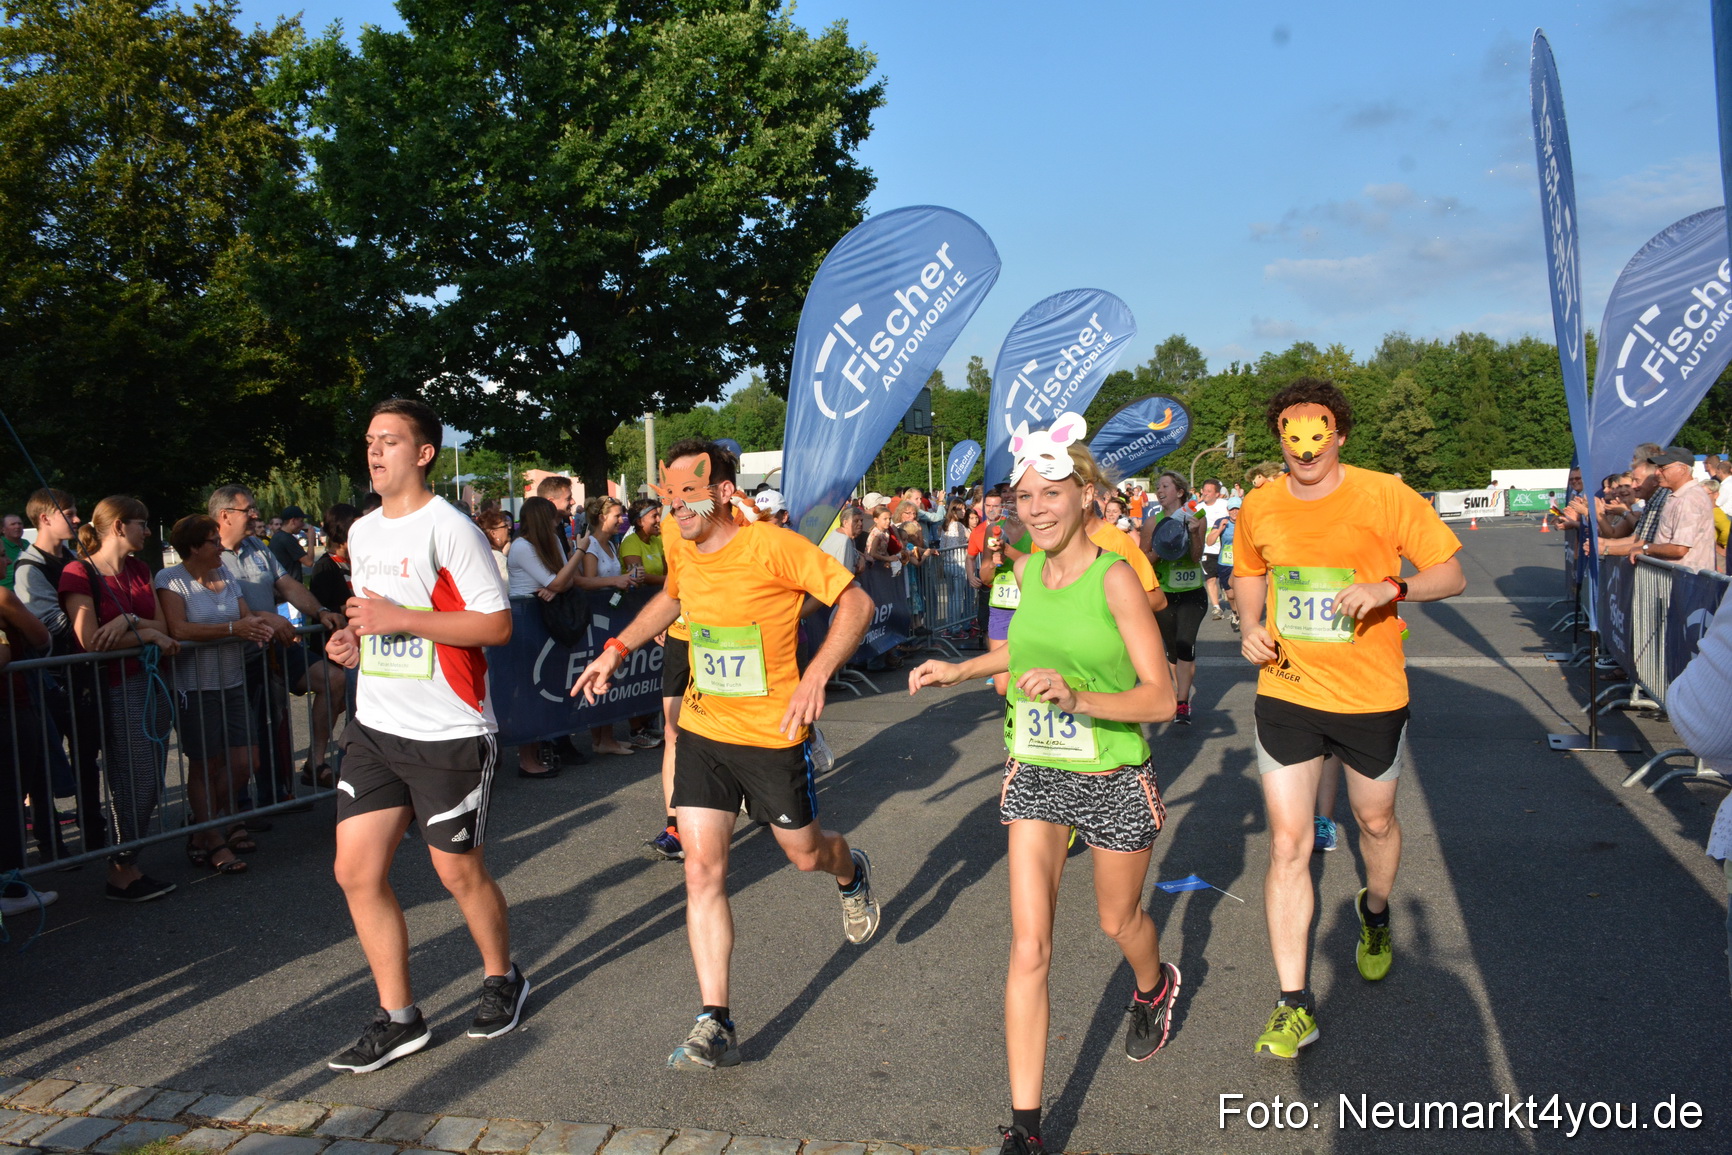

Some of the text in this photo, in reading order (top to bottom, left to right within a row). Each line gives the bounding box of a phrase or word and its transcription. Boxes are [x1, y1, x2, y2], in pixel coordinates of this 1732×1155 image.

[841, 241, 954, 394] Fischer
[881, 270, 968, 392] AUTOMOBILE
[1641, 257, 1731, 384] Fische
[1679, 299, 1732, 381] AUTOMO
[1023, 311, 1103, 423] Fischer
[1052, 331, 1113, 419] AUTOMOBILE
[1128, 445, 1149, 462] Druck
[1160, 425, 1185, 443] Medien
[955, 445, 974, 476] Fischer
[1513, 493, 1533, 504] AOK
[354, 555, 410, 579] Xplus1
[1175, 571, 1196, 581] 309
[998, 586, 1019, 599] 311
[1288, 596, 1336, 621] 318
[368, 634, 424, 659] 1608
[703, 653, 746, 678] 317
[1028, 708, 1077, 738] 313
